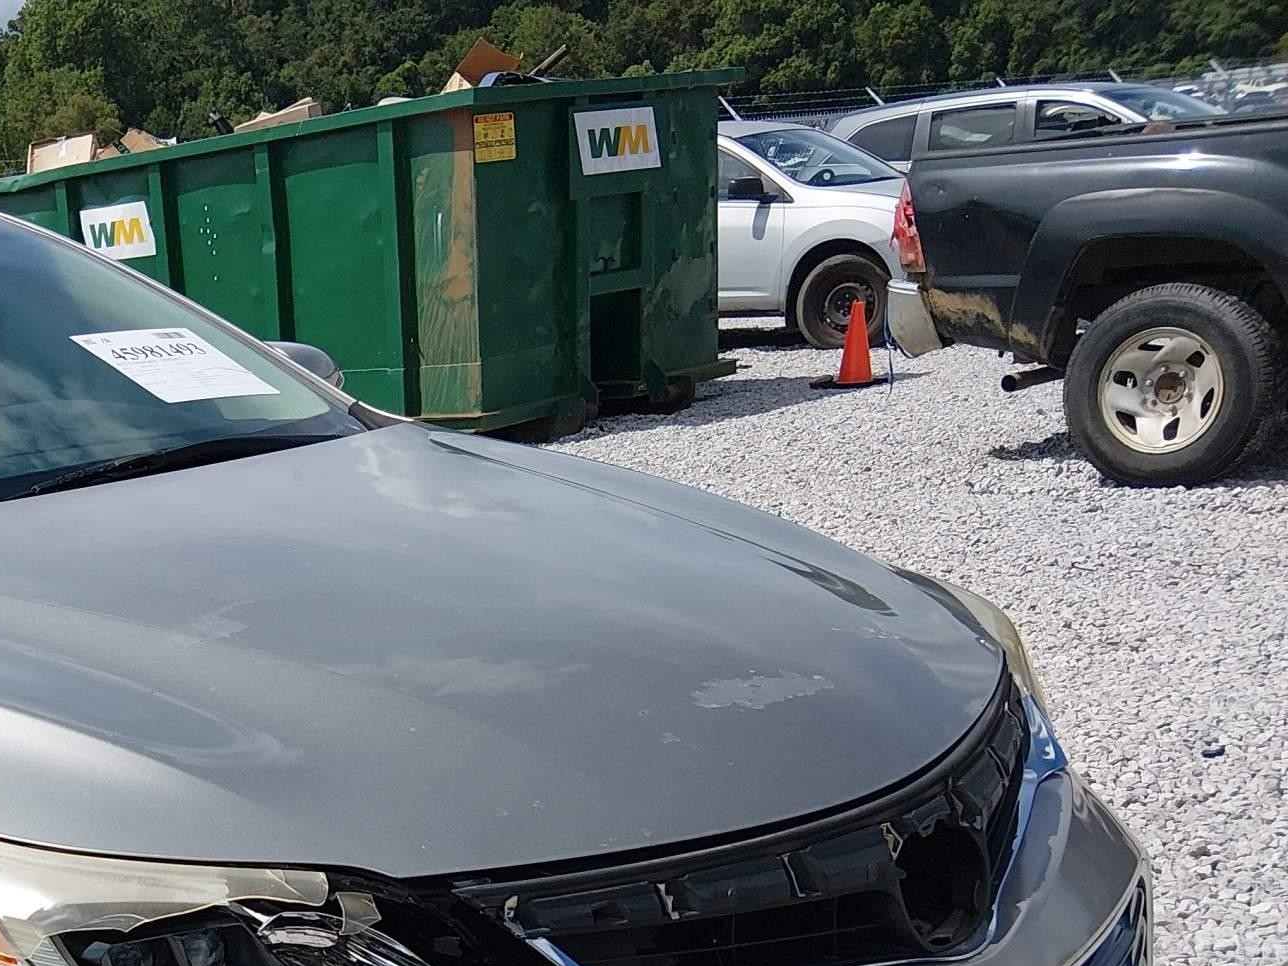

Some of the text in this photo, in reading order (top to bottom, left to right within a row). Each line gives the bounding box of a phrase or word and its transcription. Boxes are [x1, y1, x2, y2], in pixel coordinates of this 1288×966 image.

[587, 125, 651, 158] WM
[89, 217, 145, 249] WM
[111, 343, 207, 360] 45981493
